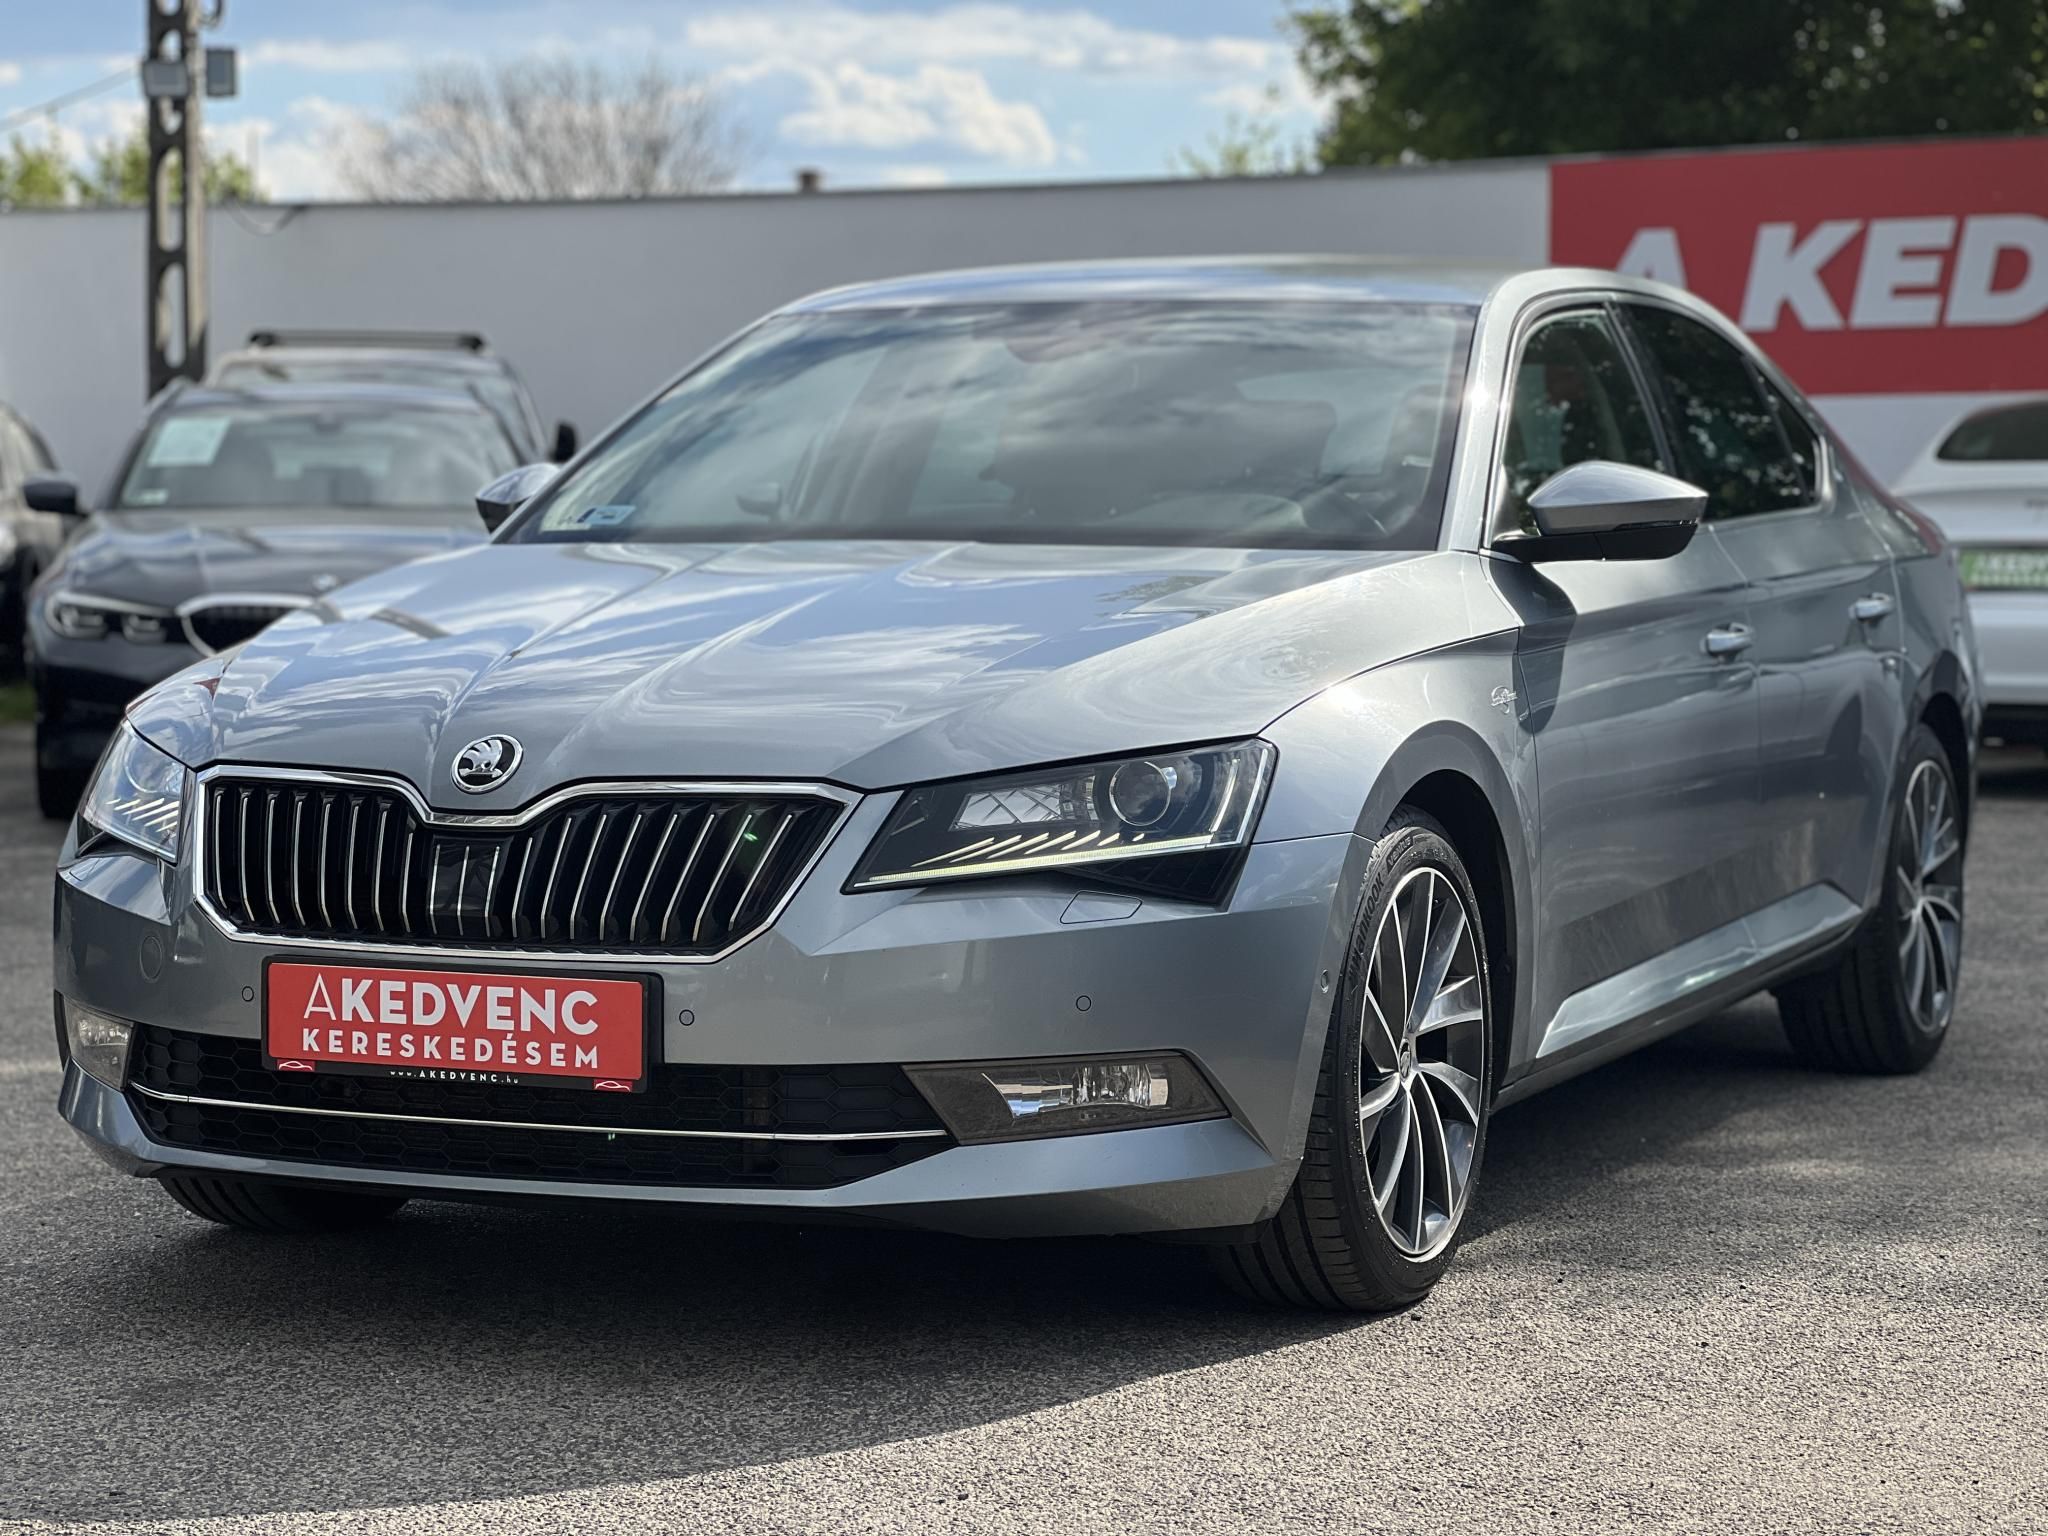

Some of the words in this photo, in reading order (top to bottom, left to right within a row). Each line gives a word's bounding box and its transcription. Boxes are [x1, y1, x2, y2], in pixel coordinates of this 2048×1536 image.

[1738, 213, 2048, 332] KED
[302, 1028, 599, 1070] KERESKEDÉSEM
[390, 1069, 519, 1085] www.AKEDVENC.hu
